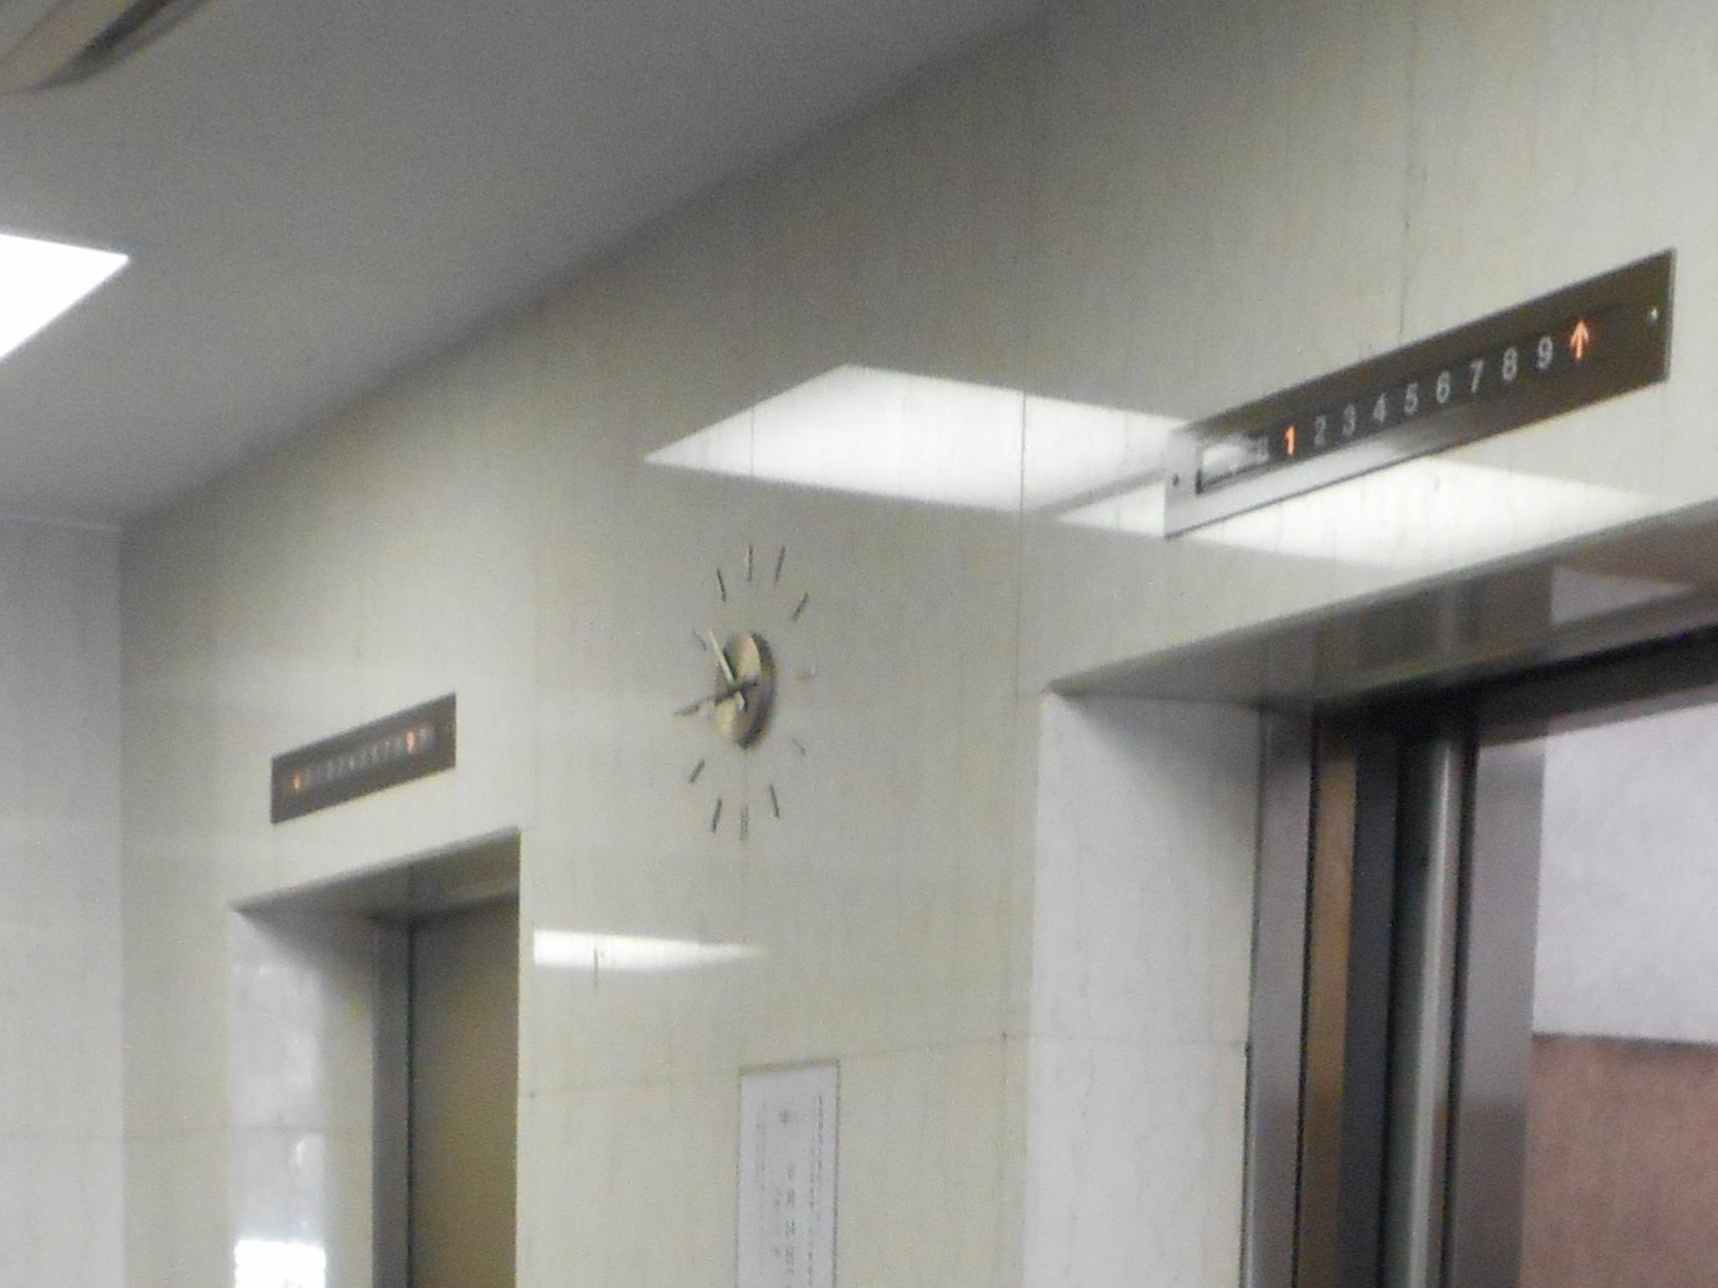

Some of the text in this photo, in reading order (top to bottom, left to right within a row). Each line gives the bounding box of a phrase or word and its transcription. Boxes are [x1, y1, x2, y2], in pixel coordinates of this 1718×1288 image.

[1286, 425, 1296, 457] 1
[1314, 416, 1326, 446] 2
[1343, 405, 1356, 436] 3
[1373, 391, 1386, 422] 4
[1404, 383, 1418, 415] 5
[1436, 370, 1451, 404] 6
[1469, 360, 1483, 393] 7
[1502, 347, 1518, 381] 8
[1537, 336, 1553, 370] 9
